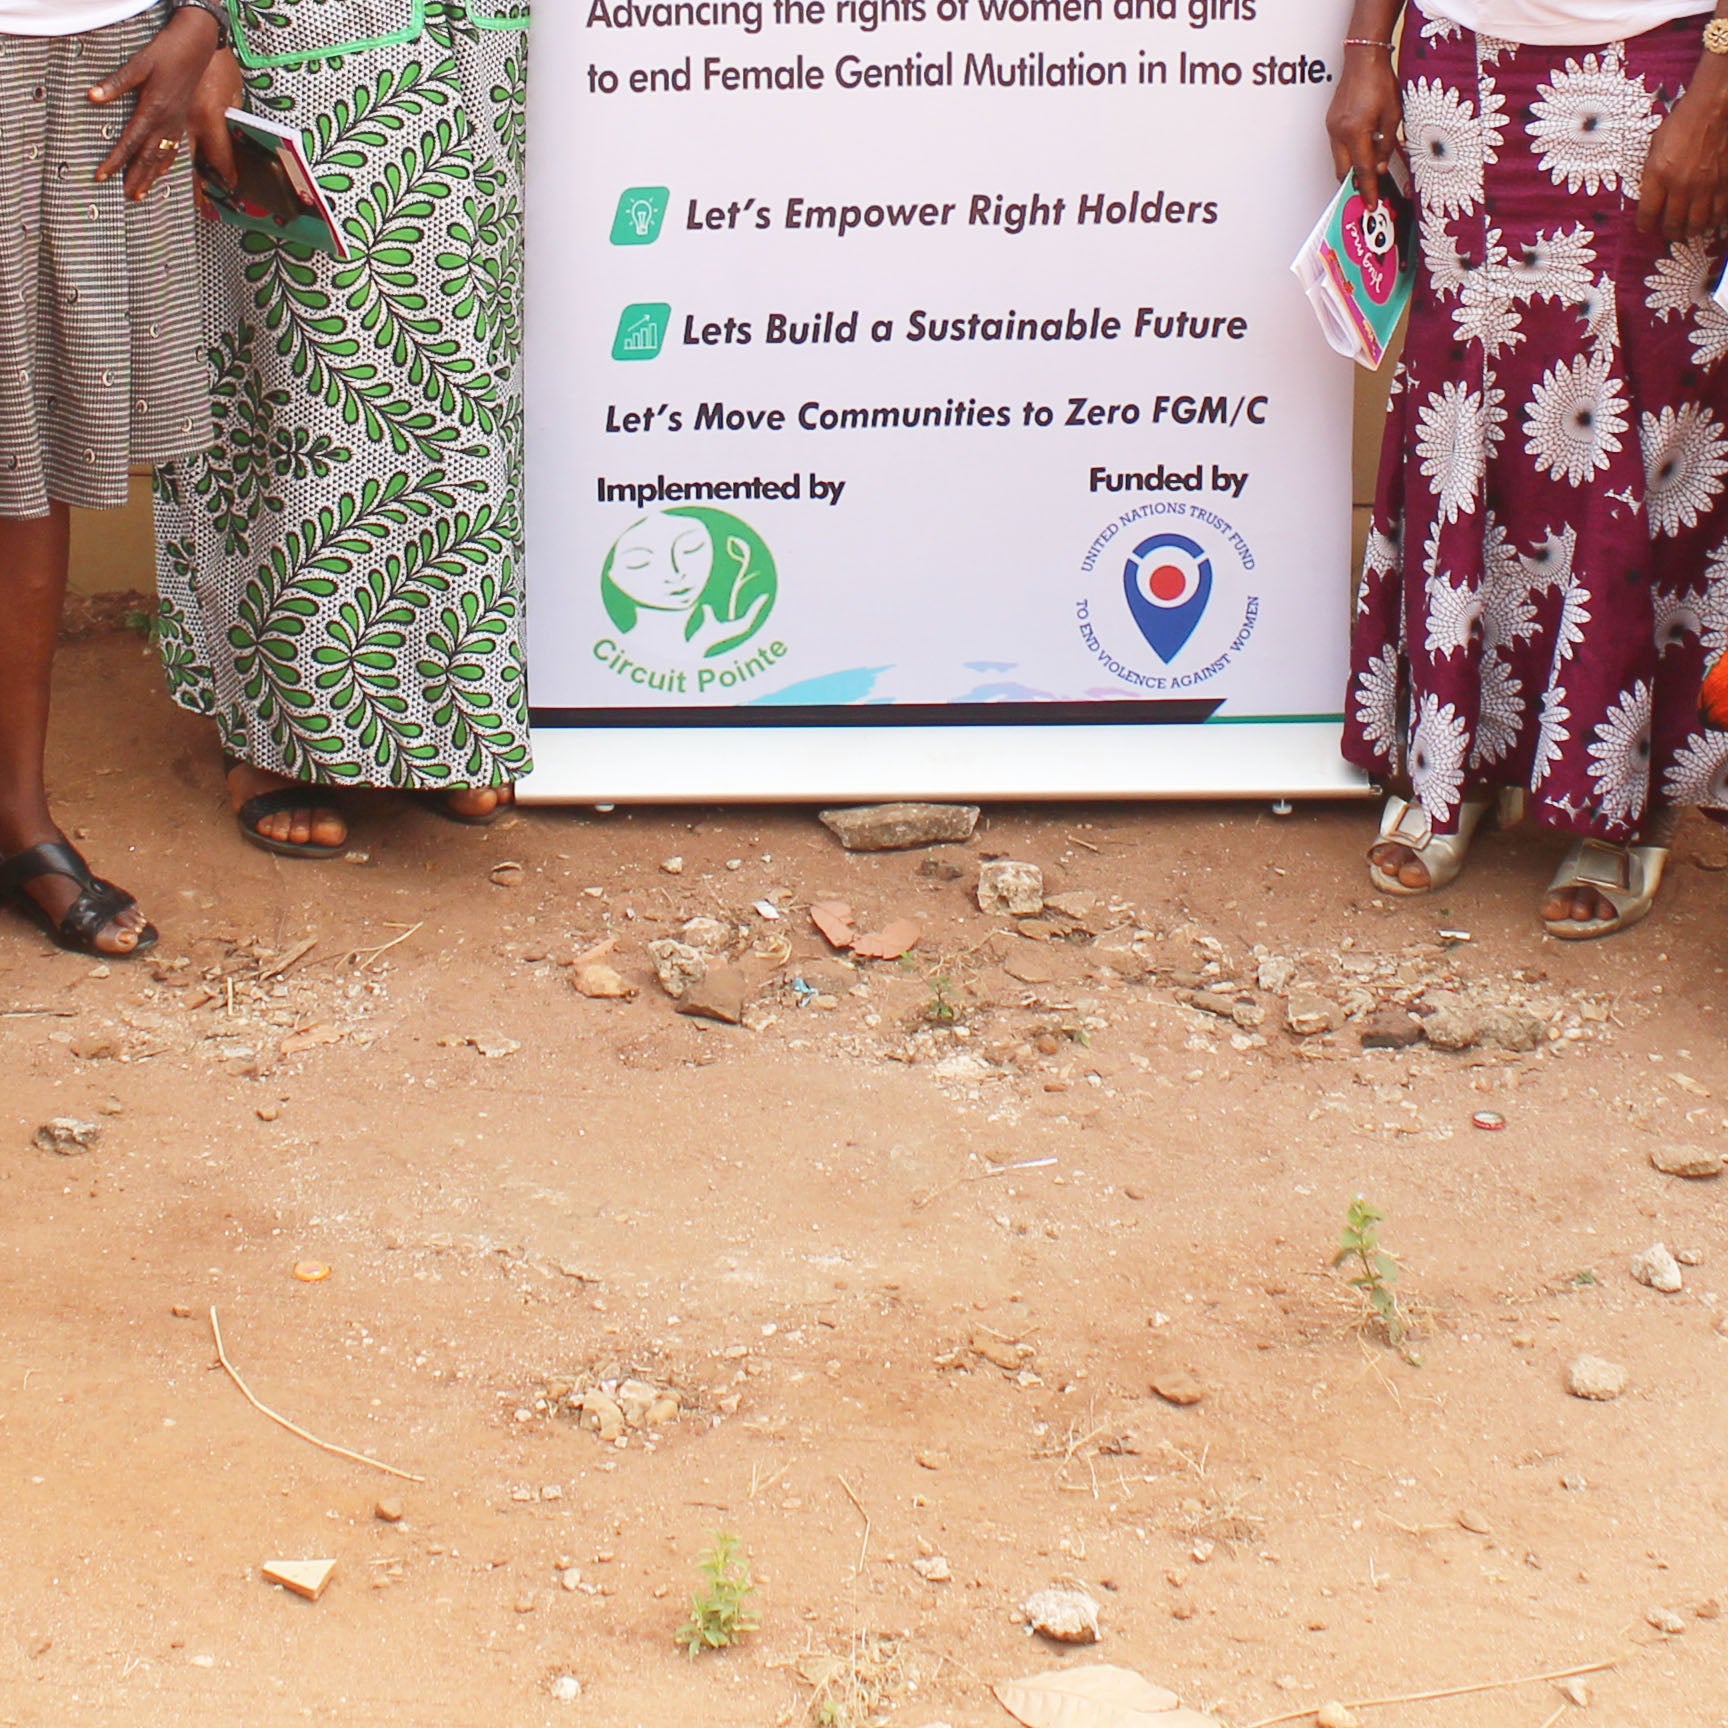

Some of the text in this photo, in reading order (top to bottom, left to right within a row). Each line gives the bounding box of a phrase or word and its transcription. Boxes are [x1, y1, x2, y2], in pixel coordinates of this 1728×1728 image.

[587, 50, 1334, 94] to end Female Gential Mutilation in Imo state.
[686, 190, 1219, 233] Let's Empower Right Holders
[683, 307, 1248, 348] Lets Build a Sustainable Future
[604, 394, 1269, 435] Let's Move Communities to Zero FGM/C
[597, 472, 846, 508] Implemented by
[1090, 465, 1249, 499] Funded by
[1080, 501, 1255, 573] UNITED NATIONS TRUST FUND
[1076, 596, 1260, 689] TO END VIOLENCE AGAINST WOMEN
[593, 638, 788, 693] Circuit Pointe
